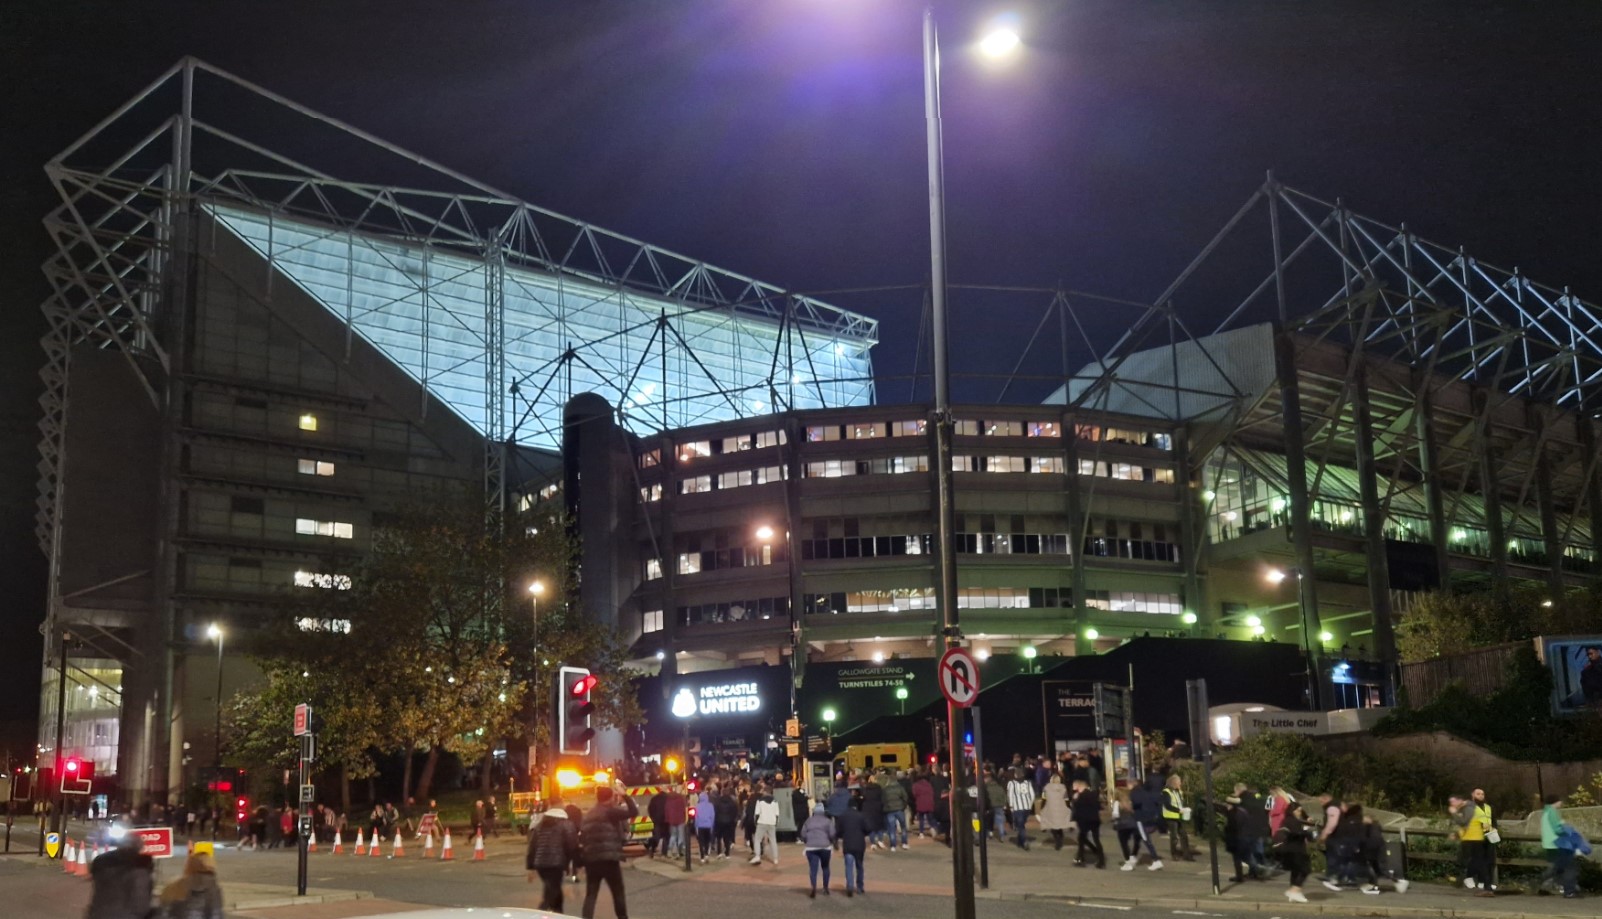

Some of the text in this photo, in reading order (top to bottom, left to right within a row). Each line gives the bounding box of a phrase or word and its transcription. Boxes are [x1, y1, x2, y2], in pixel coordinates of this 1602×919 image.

[838, 668, 880, 676] GALLOWGATE
[838, 681, 883, 689] TURNSTILES
[700, 683, 758, 698] NEWCASTLE
[700, 696, 760, 714] UNITED
[1058, 698, 1096, 707] TERRAC
[1253, 719, 1318, 728] The Little Chef
